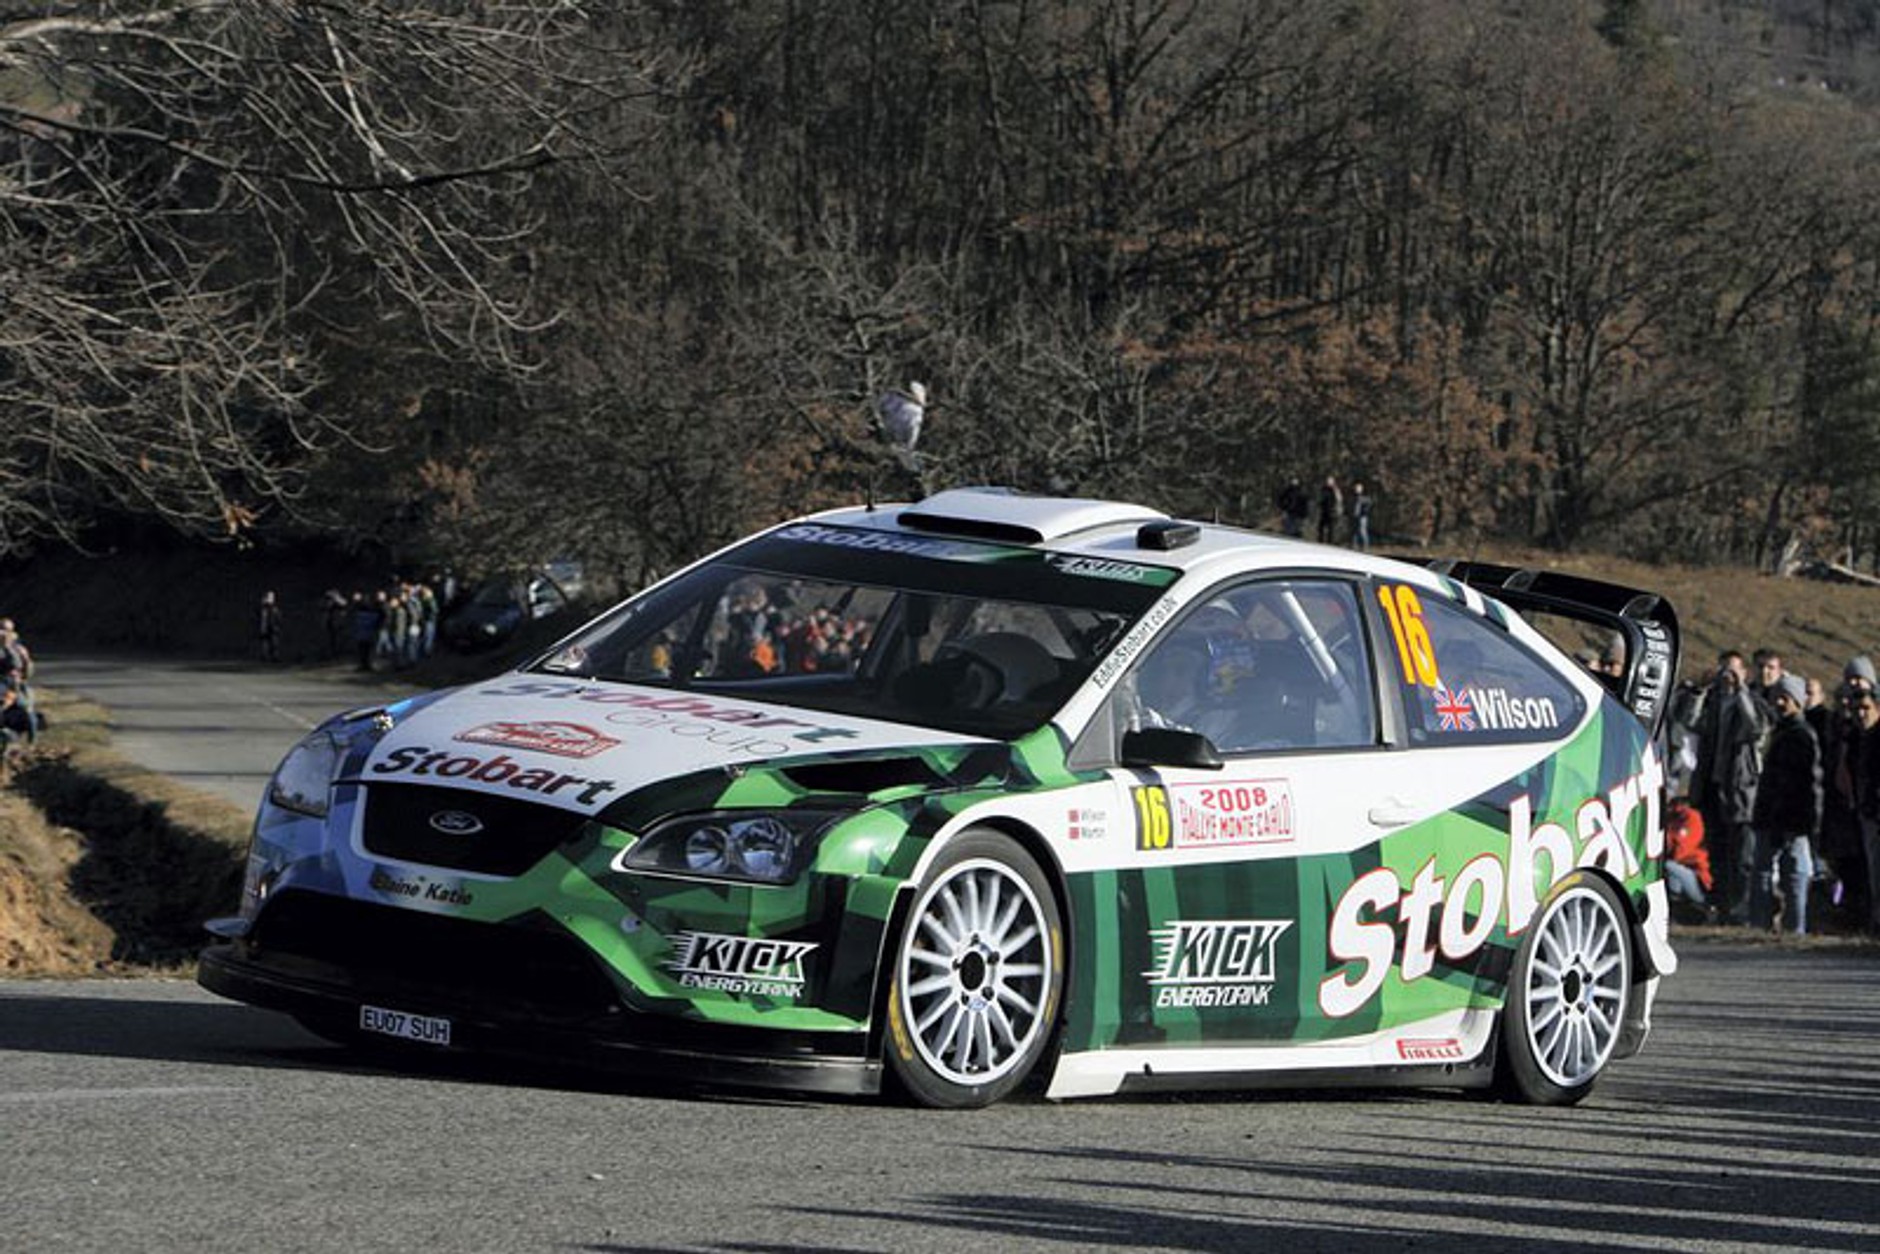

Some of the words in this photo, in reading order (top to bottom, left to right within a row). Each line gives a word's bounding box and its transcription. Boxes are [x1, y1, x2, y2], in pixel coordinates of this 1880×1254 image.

[1379, 584, 1439, 689] 16
[1468, 687, 1559, 730] Wilson
[372, 747, 616, 806] Stobart
[1200, 786, 1268, 812] 2008
[1135, 786, 1170, 849] 16
[1219, 814, 1254, 839] MONTE
[1256, 793, 1292, 837] CARLO
[1317, 741, 1666, 1019] Stobart
[684, 932, 821, 983] KICK
[1160, 920, 1294, 983] KICK
[364, 1008, 405, 1033] EU07
[411, 1016, 448, 1042] SUH
